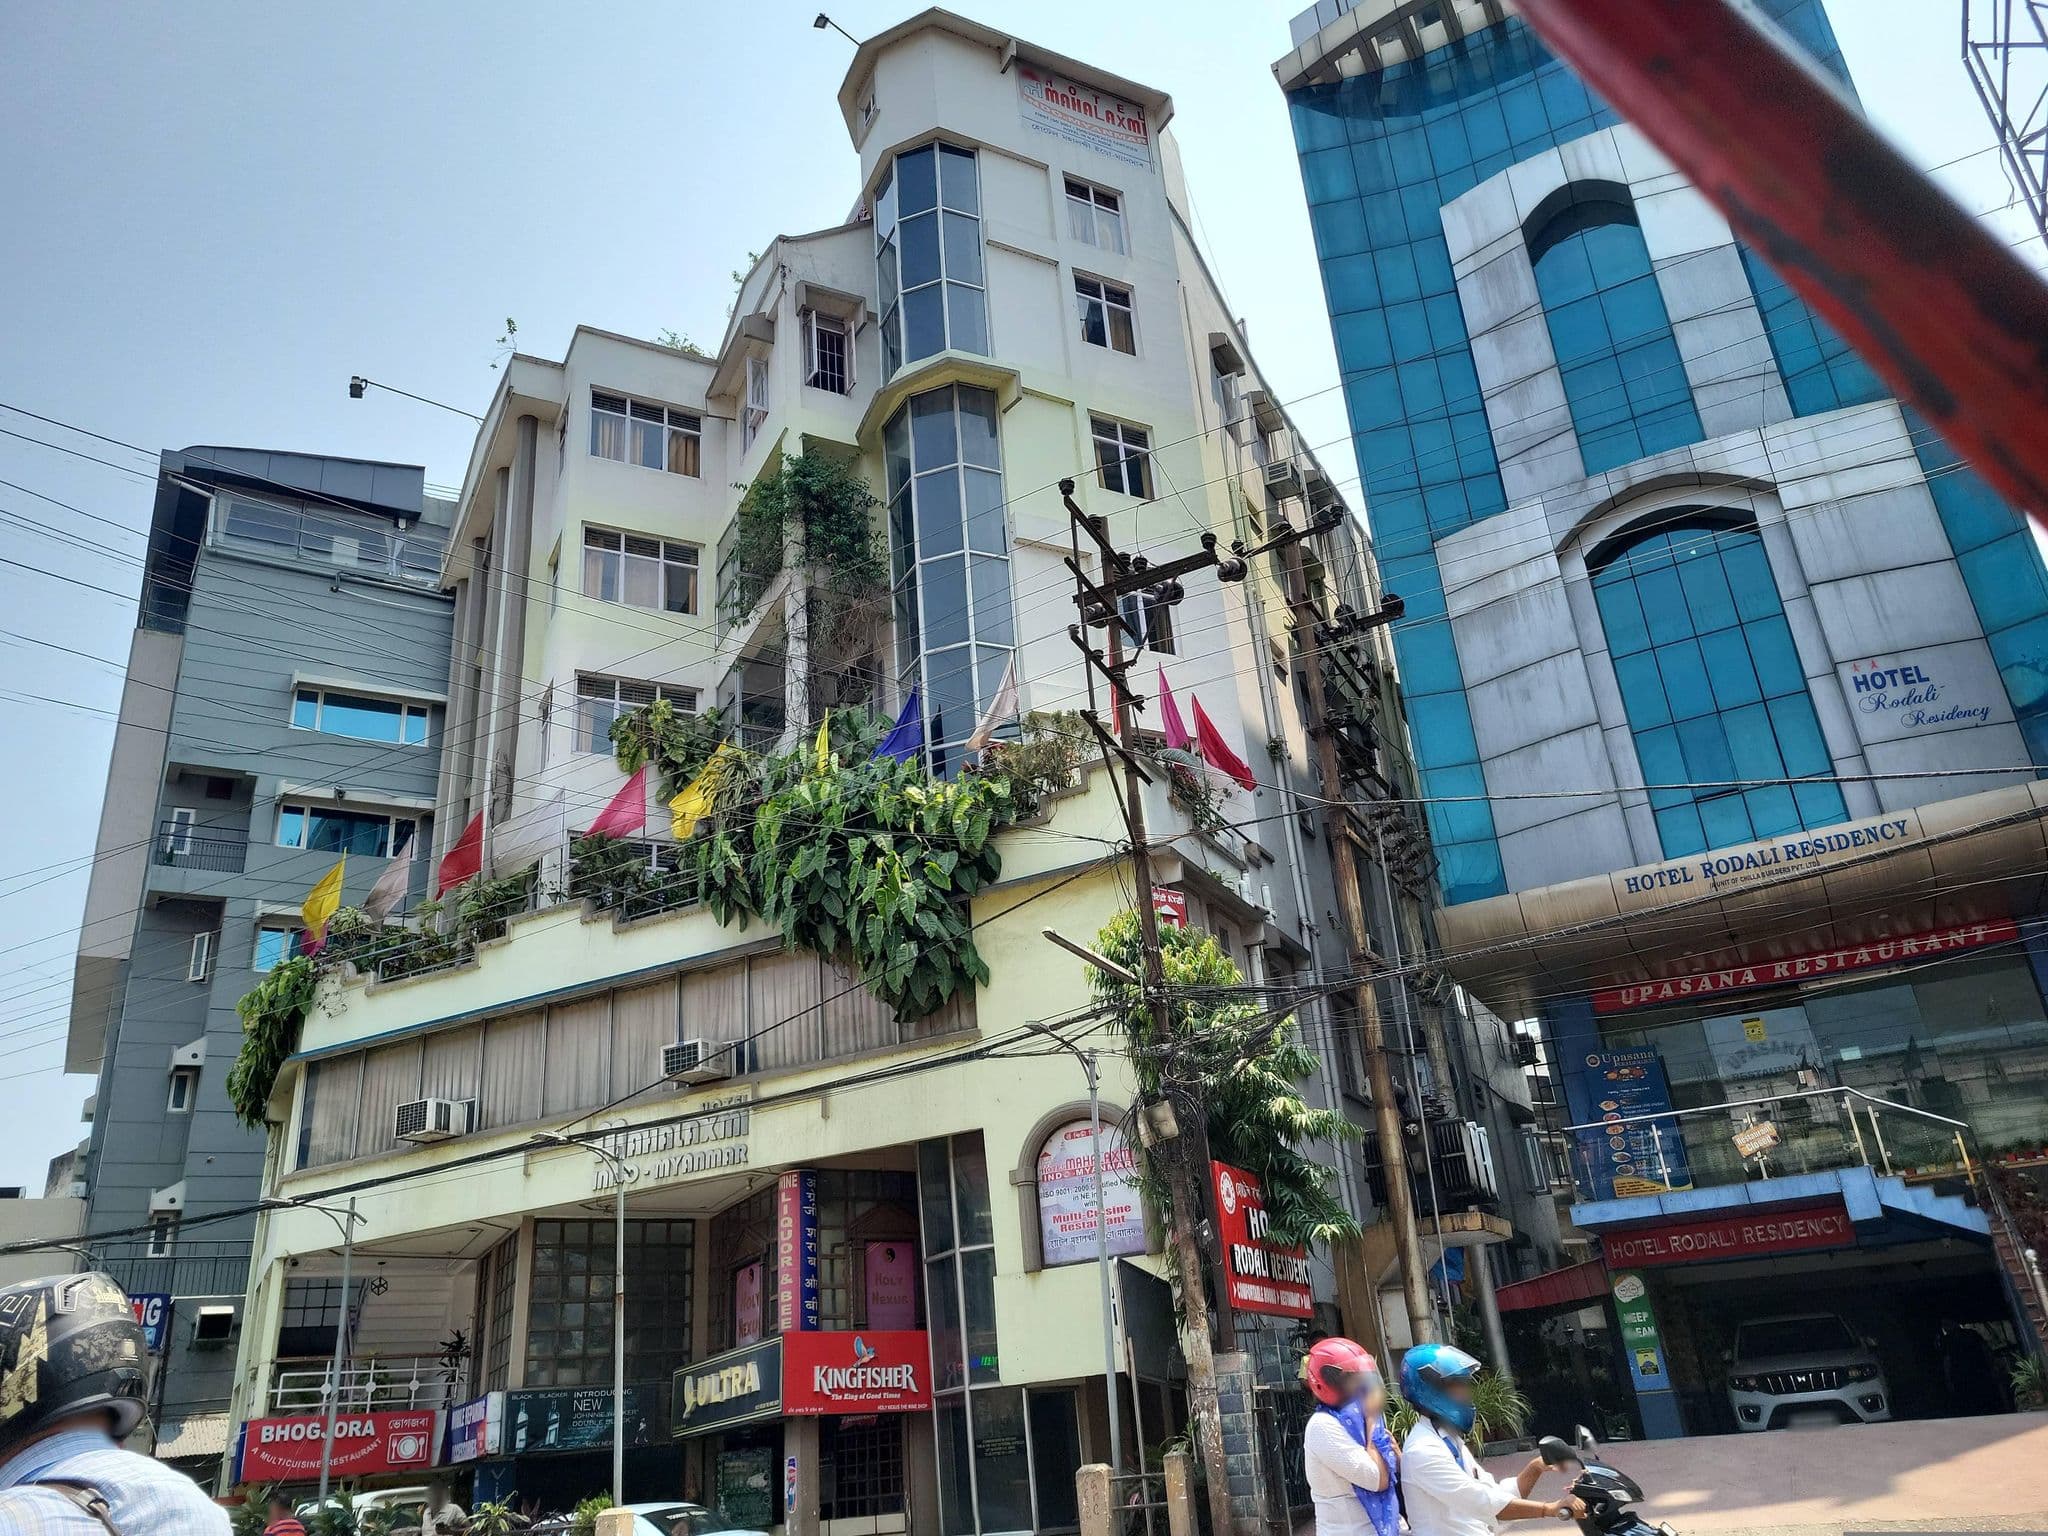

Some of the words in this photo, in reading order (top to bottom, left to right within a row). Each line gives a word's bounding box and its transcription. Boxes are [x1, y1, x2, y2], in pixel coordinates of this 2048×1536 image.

[1045, 87, 1147, 136] MAHALAXMI
[1853, 666, 1930, 693] HOTEL
[1859, 684, 1944, 713] Rodali
[1901, 704, 1992, 728] Residency
[1625, 866, 1694, 894] HOTEL
[1700, 847, 1781, 879] RODALI
[1783, 819, 1908, 862] RESIDENCY
[1620, 968, 1757, 1006] UPASANA
[1774, 925, 1988, 978] RESTAURANT
[1602, 1051, 1655, 1066] Upasana
[593, 1109, 749, 1163] MAHALAXMI
[654, 1143, 748, 1179] MYANMAR
[1053, 1204, 1132, 1224] Multi-Cusine
[781, 1192, 793, 1267] LIQUOR
[1611, 1238, 1667, 1259] HOTEL
[1669, 1229, 1736, 1253] RODALI
[1743, 1215, 1845, 1245] RESIDENCY
[1234, 1243, 1269, 1278] RODALI
[781, 1273, 793, 1285] &
[875, 1272, 903, 1286] HOLY
[872, 1291, 908, 1305] NEXUS
[1623, 1311, 1649, 1324] EEP
[573, 1388, 633, 1398] INTRODUCNG
[697, 1362, 761, 1406] ULTRA
[813, 1364, 919, 1395] KINGFISHER
[511, 1393, 533, 1401] BLACK
[573, 1398, 603, 1411] NEW
[843, 1392, 858, 1401] King
[866, 1391, 882, 1400] Good
[251, 1447, 259, 1455] A
[260, 1452, 321, 1468] MULTICUISINE
[328, 1438, 383, 1467] RESTAURANT
